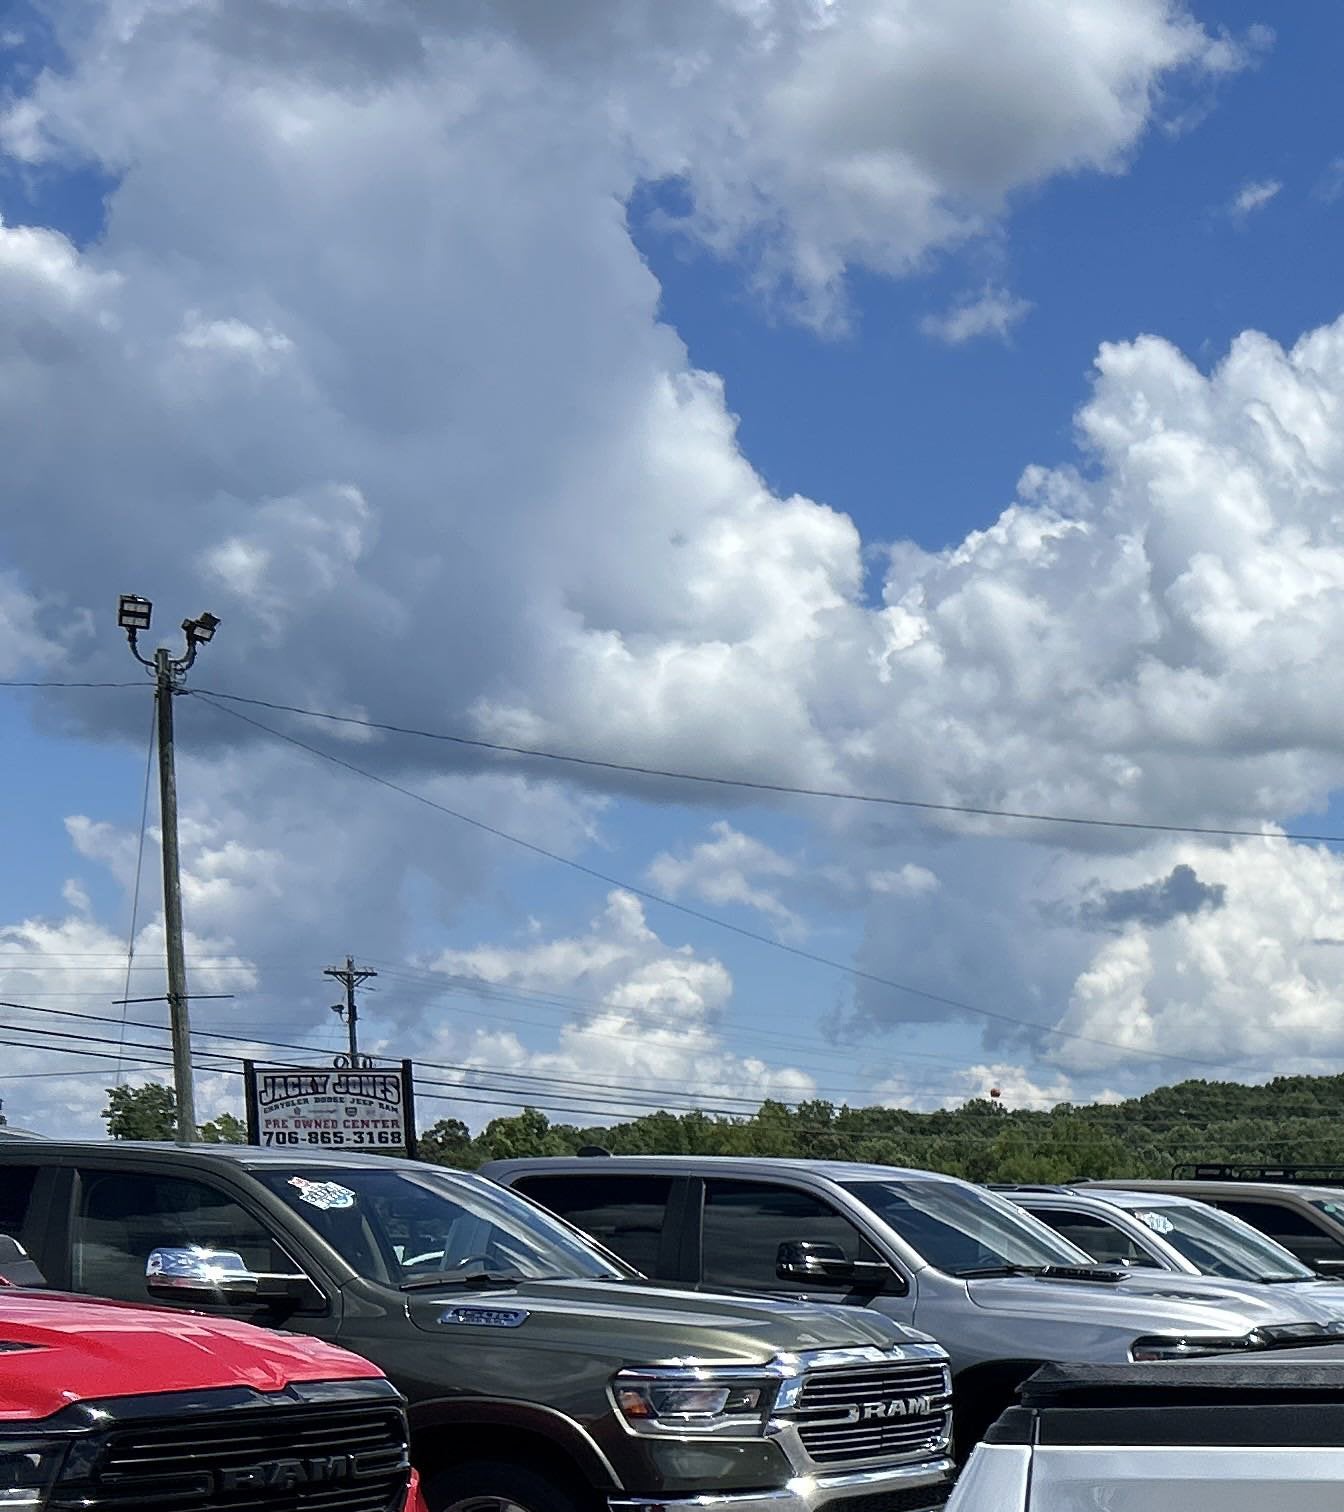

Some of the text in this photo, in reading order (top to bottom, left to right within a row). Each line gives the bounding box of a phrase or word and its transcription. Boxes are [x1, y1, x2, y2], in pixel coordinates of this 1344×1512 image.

[259, 1075, 400, 1105] JACKY JONES
[314, 1096, 345, 1104] DODGE
[350, 1097, 374, 1107] JEEP
[378, 1102, 399, 1114] RAM
[264, 1119, 400, 1129] PRE OWNED CENTER
[262, 1131, 401, 1146] 706-865-3168
[863, 1395, 931, 1420] RAM
[219, 1455, 348, 1489] RAM
